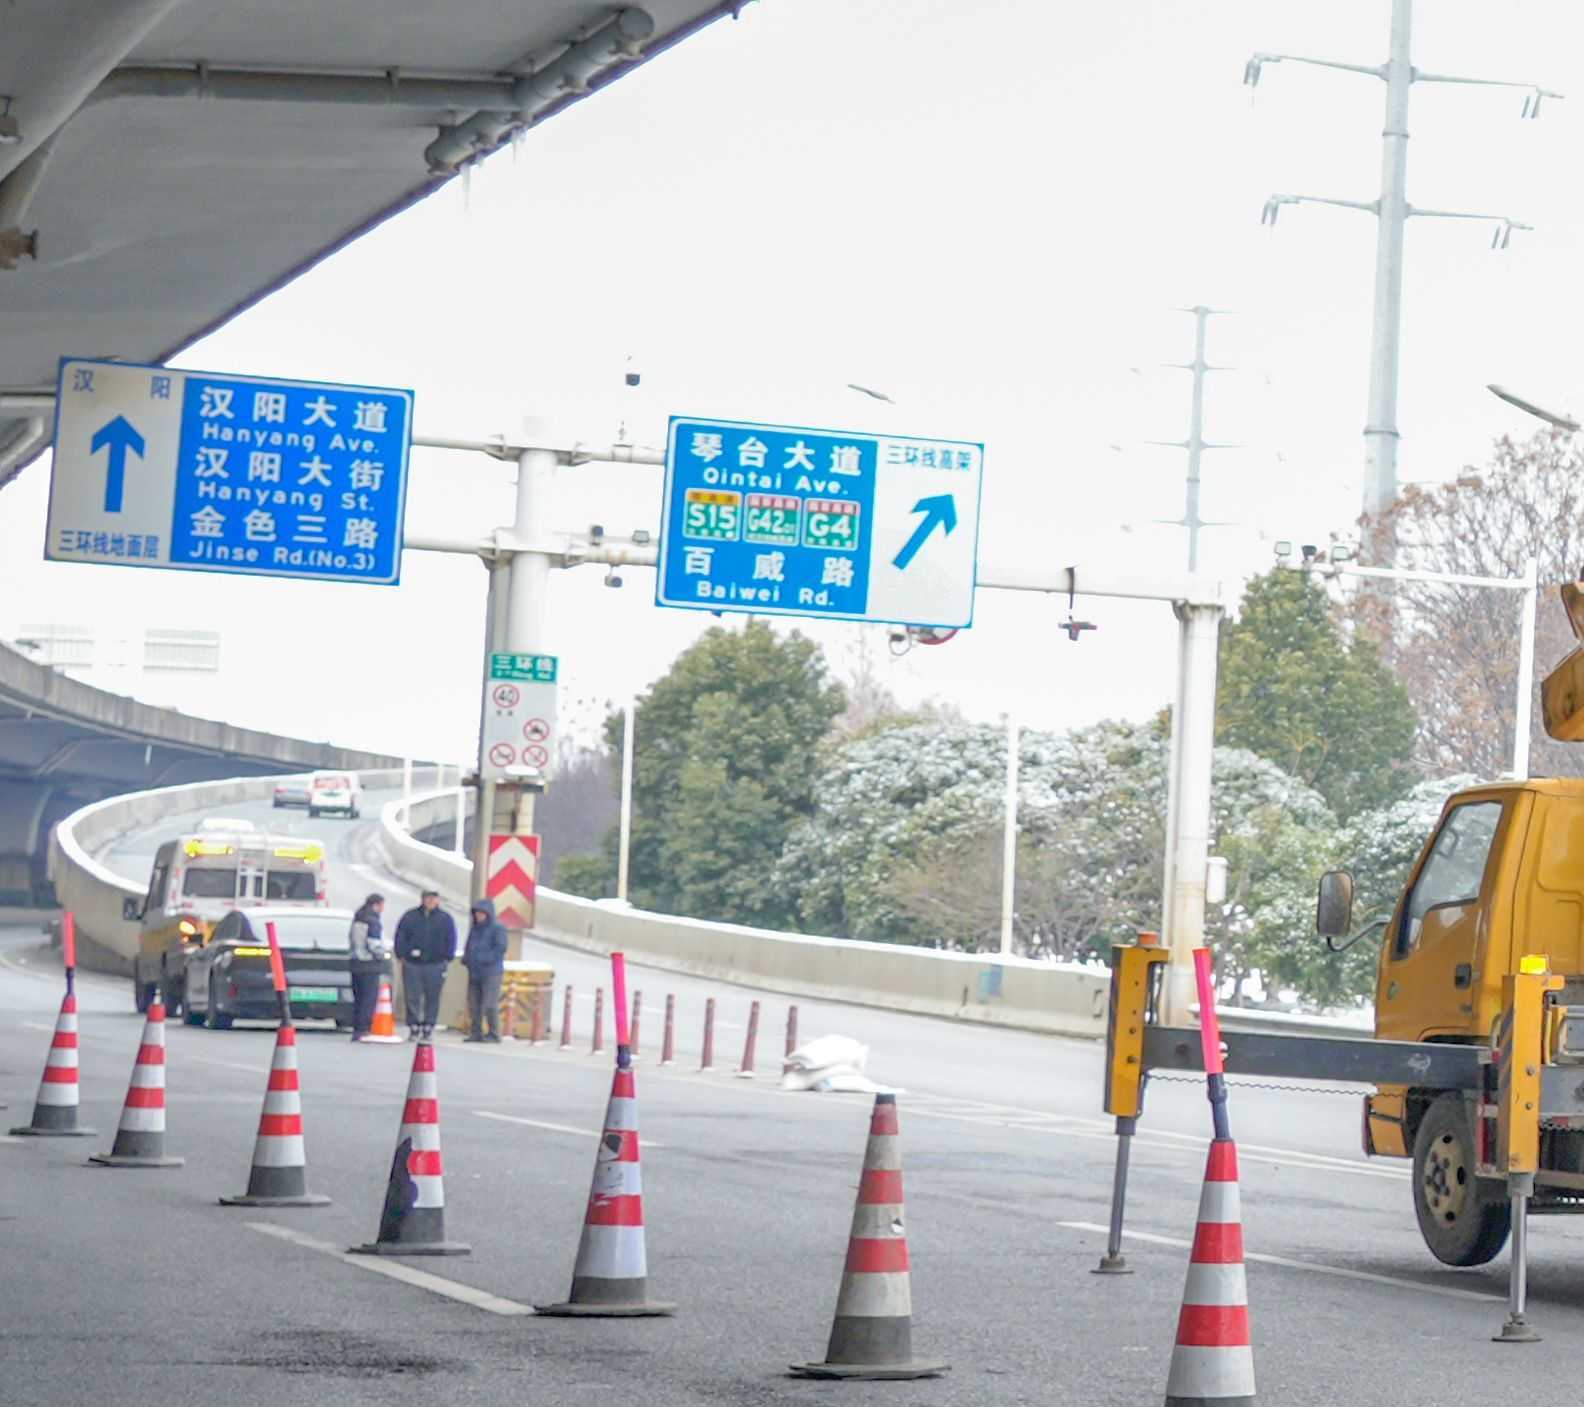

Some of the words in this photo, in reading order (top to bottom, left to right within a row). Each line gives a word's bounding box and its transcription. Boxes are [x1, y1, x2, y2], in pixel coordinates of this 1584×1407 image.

[73, 369, 170, 400] 汉阳
[200, 385, 387, 433] 汉阳大道
[202, 423, 315, 452] Hanyang
[329, 433, 379, 453] Ave.
[194, 446, 384, 491] 汉阳大街
[691, 432, 862, 476] 琴台大道
[198, 481, 323, 511] Hanyang
[341, 492, 374, 511] St.
[703, 467, 782, 489] Qintai
[795, 475, 849, 495] Ave.
[190, 504, 378, 549] 金色三路
[688, 503, 737, 529] S15
[809, 513, 852, 538] G4
[189, 541, 260, 562] Jinse
[683, 546, 854, 587] 百威路
[696, 580, 780, 602] Baiwei
[798, 587, 835, 606] Rd.
